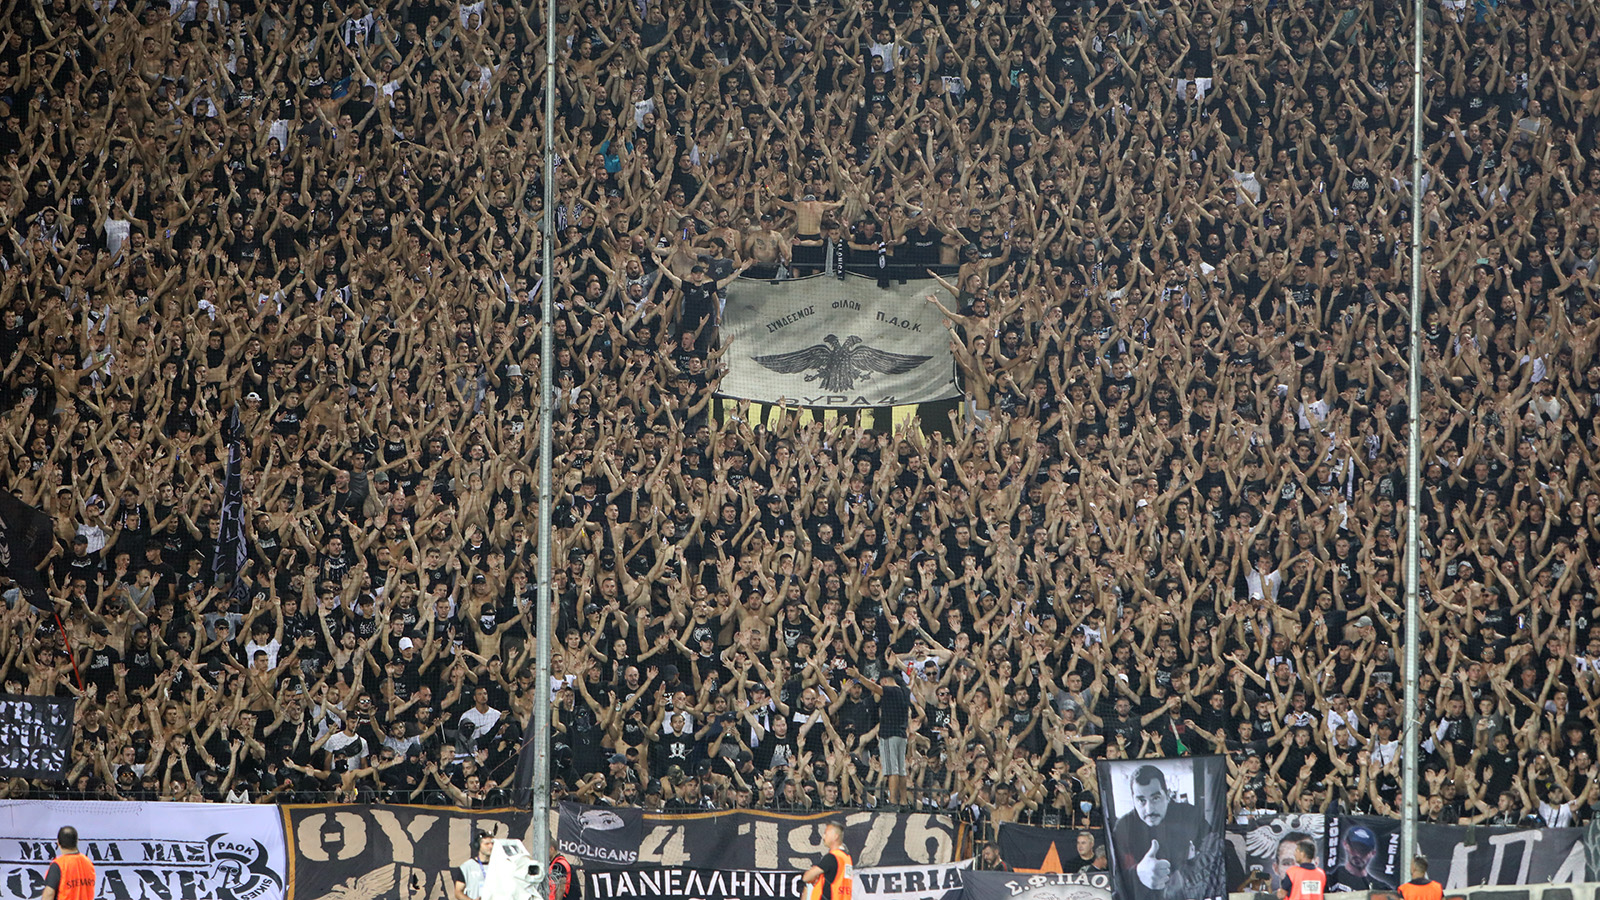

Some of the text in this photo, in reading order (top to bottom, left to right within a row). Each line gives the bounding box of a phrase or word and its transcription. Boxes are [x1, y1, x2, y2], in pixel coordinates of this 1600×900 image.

[766, 300, 922, 333] ΣΥΝΔΕΣΜΟΣ ΦΙΛΩΝ Π.Α.Ο.Κ.
[217, 841, 255, 855] PAOK
[559, 839, 637, 861] HOOLIGANS
[860, 868, 963, 894] VERIA
[1005, 873, 1112, 896] Σ.Φ.ΠΑΟ
